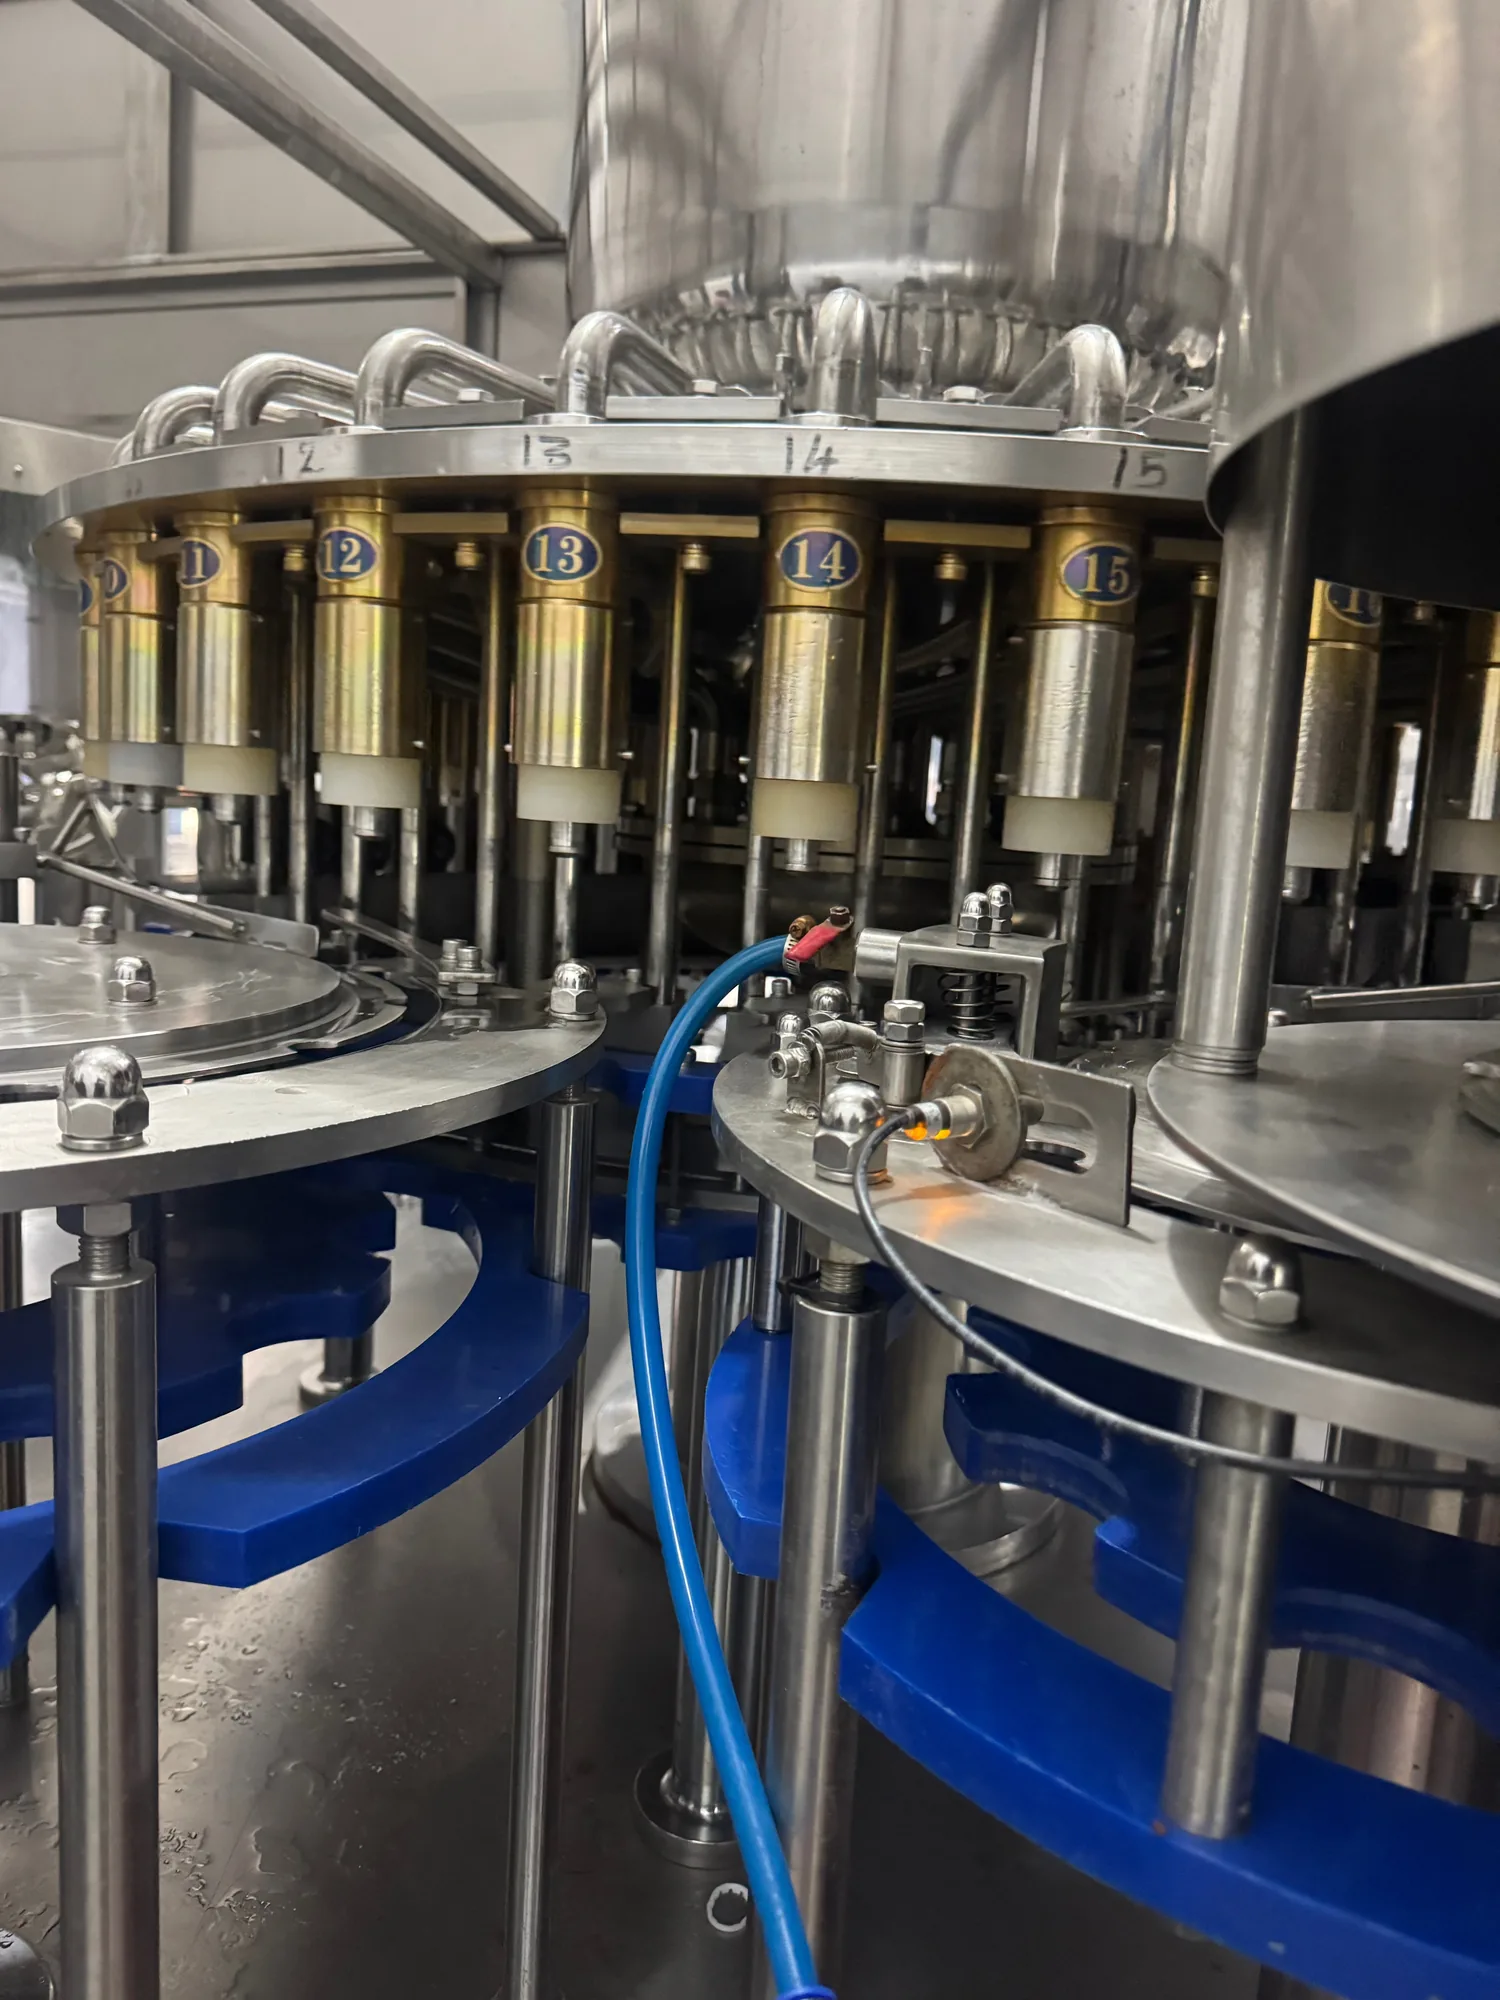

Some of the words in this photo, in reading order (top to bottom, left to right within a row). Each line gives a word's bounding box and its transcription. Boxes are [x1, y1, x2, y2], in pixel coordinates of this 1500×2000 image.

[277, 445, 324, 476] 12
[524, 433, 572, 468] 13
[786, 433, 839, 474] 14
[1113, 446, 1167, 489] 15
[323, 537, 363, 573] 12
[534, 534, 584, 574] 13
[791, 538, 846, 581] 14
[1081, 552, 1130, 595] 15
